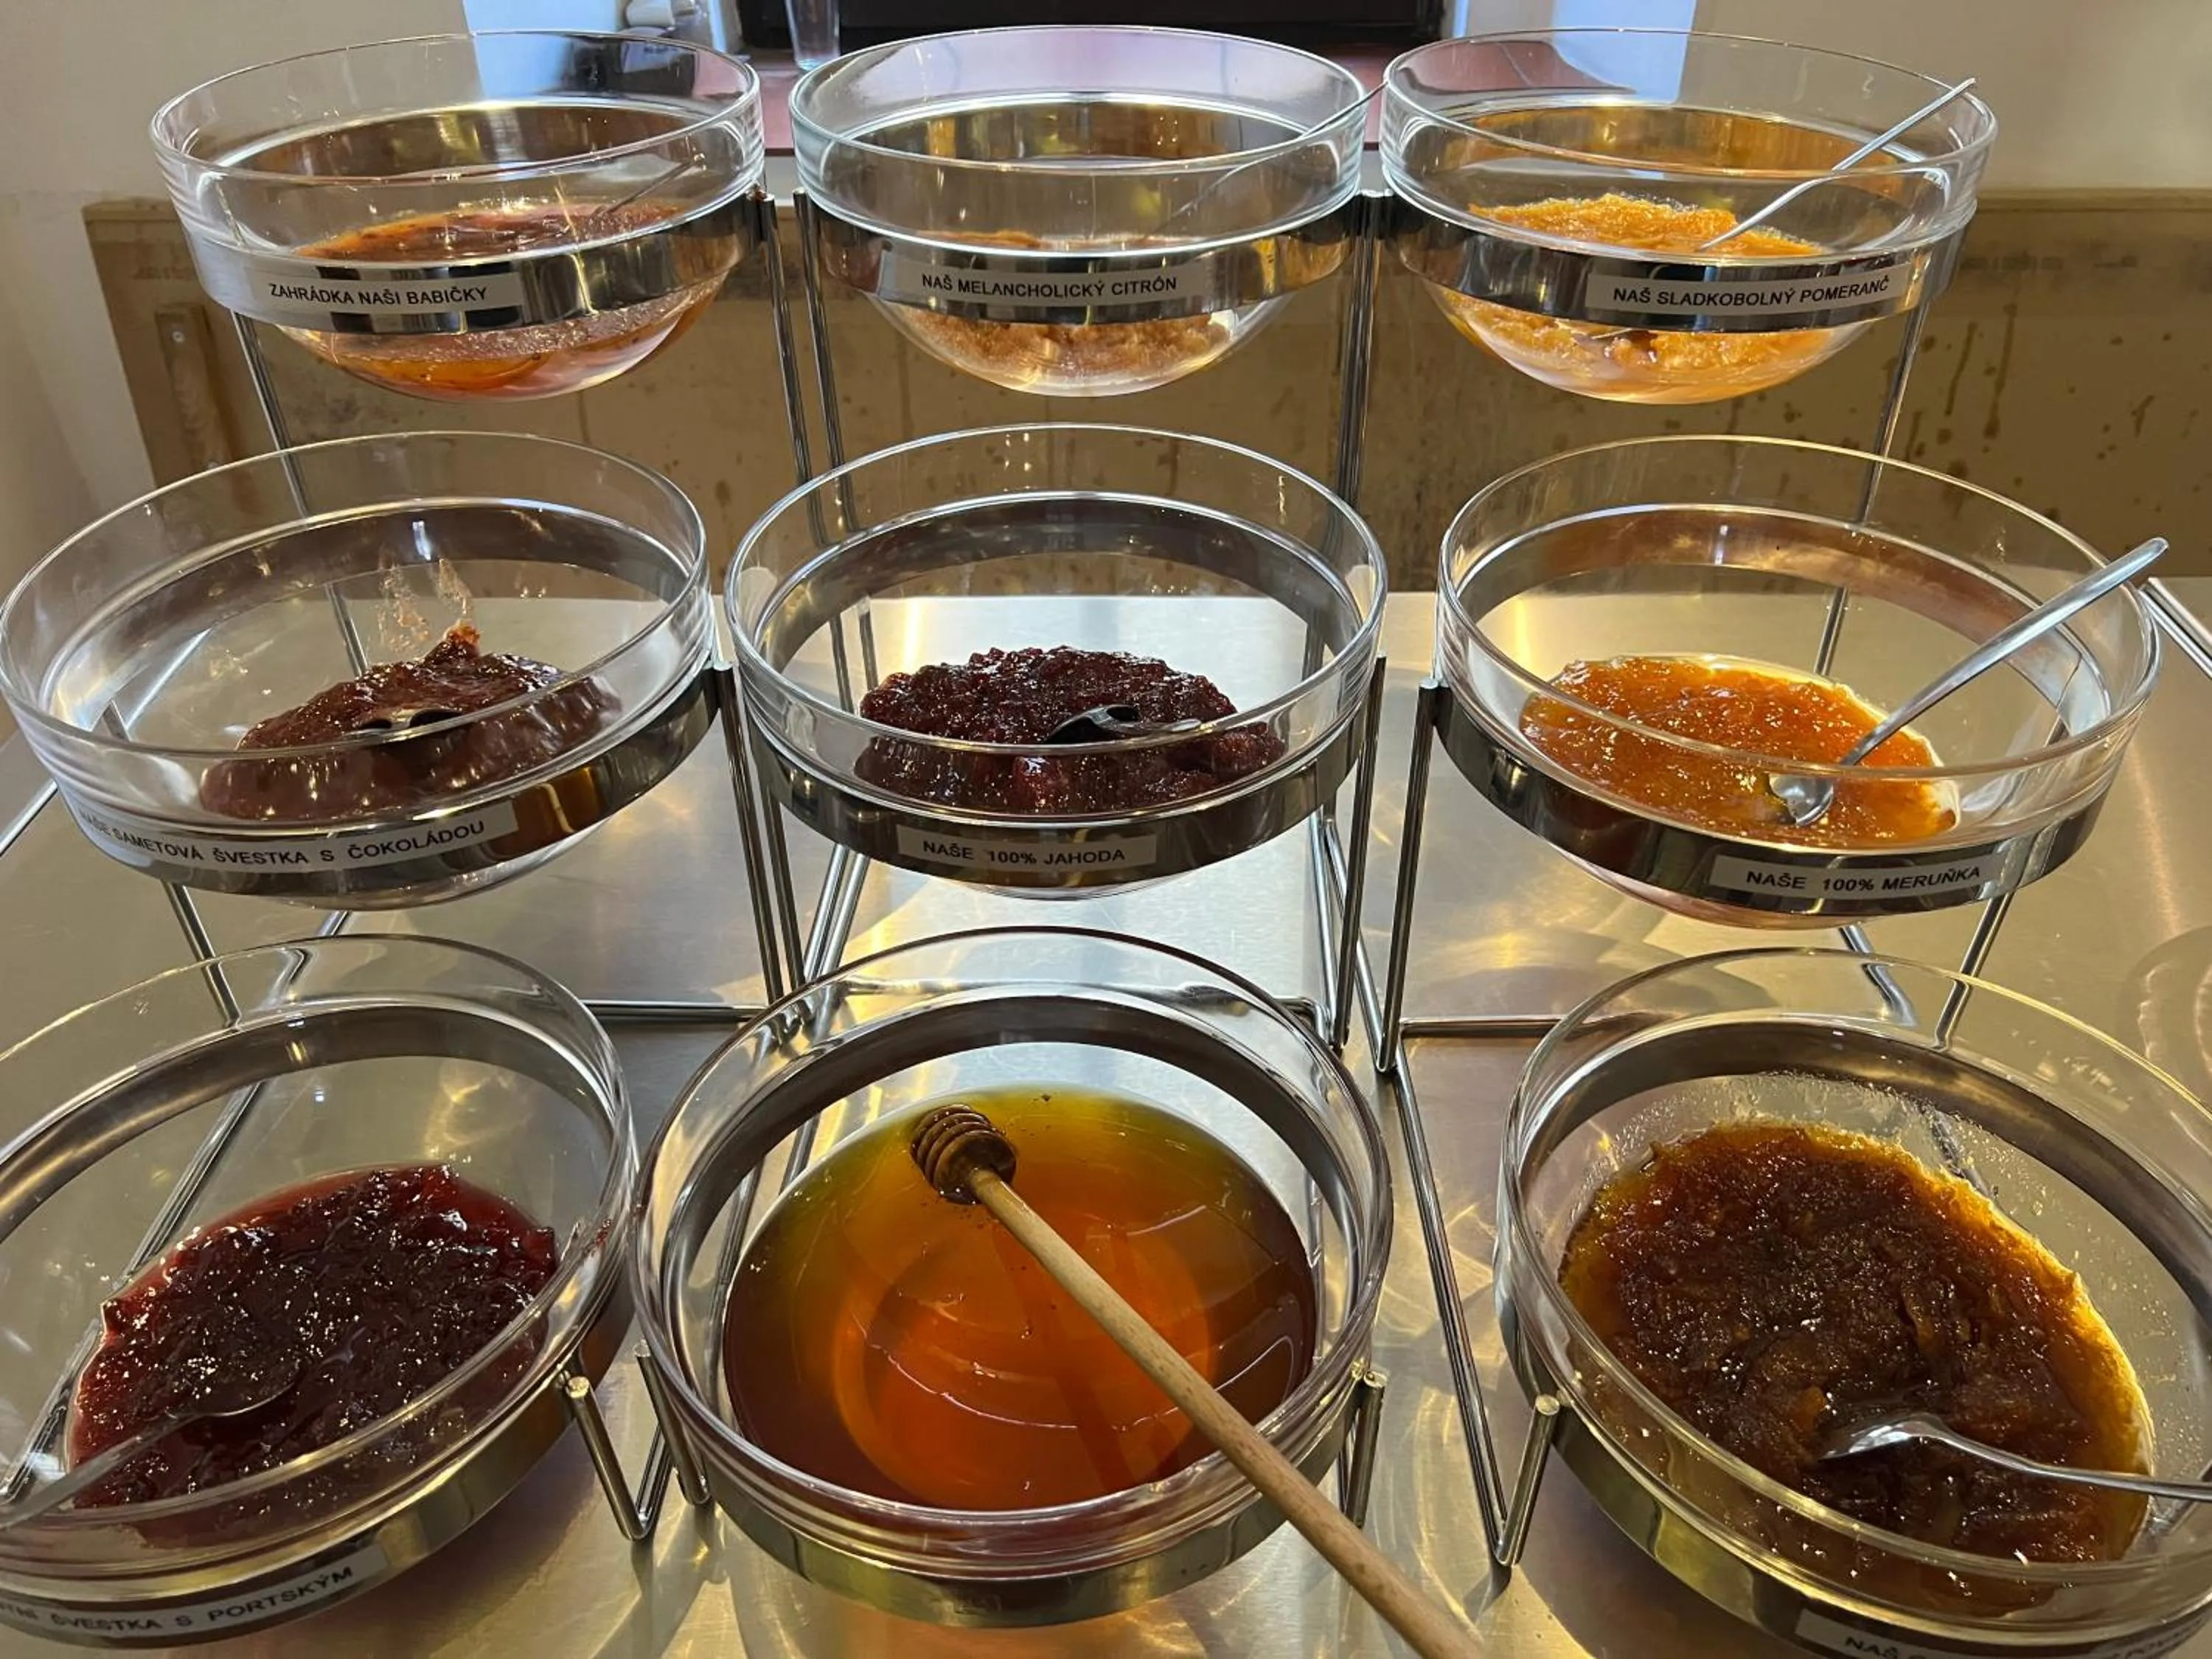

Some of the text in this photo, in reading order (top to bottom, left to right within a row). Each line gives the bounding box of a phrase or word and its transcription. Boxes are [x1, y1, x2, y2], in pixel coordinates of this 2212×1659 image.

[269, 283, 487, 305] ZAHRÁDKA NAŠI BABIČKY
[922, 274, 1177, 296] NAŠ MELANCHOLICKÝ CITRÓN
[1613, 275, 1890, 306] NAŠ SLADKOBOLNÝ POMERANČ
[212, 846, 308, 865] ŠVESTKA
[321, 849, 335, 862] S
[348, 821, 484, 859] ČOKOLÁDOU
[923, 841, 1126, 865] NAŠE 100% JAHODA
[1747, 866, 1980, 891] NAŠE 100% MERUŇKA
[176, 1615, 192, 1627] S
[209, 1566, 353, 1622] PORTSKÝM
